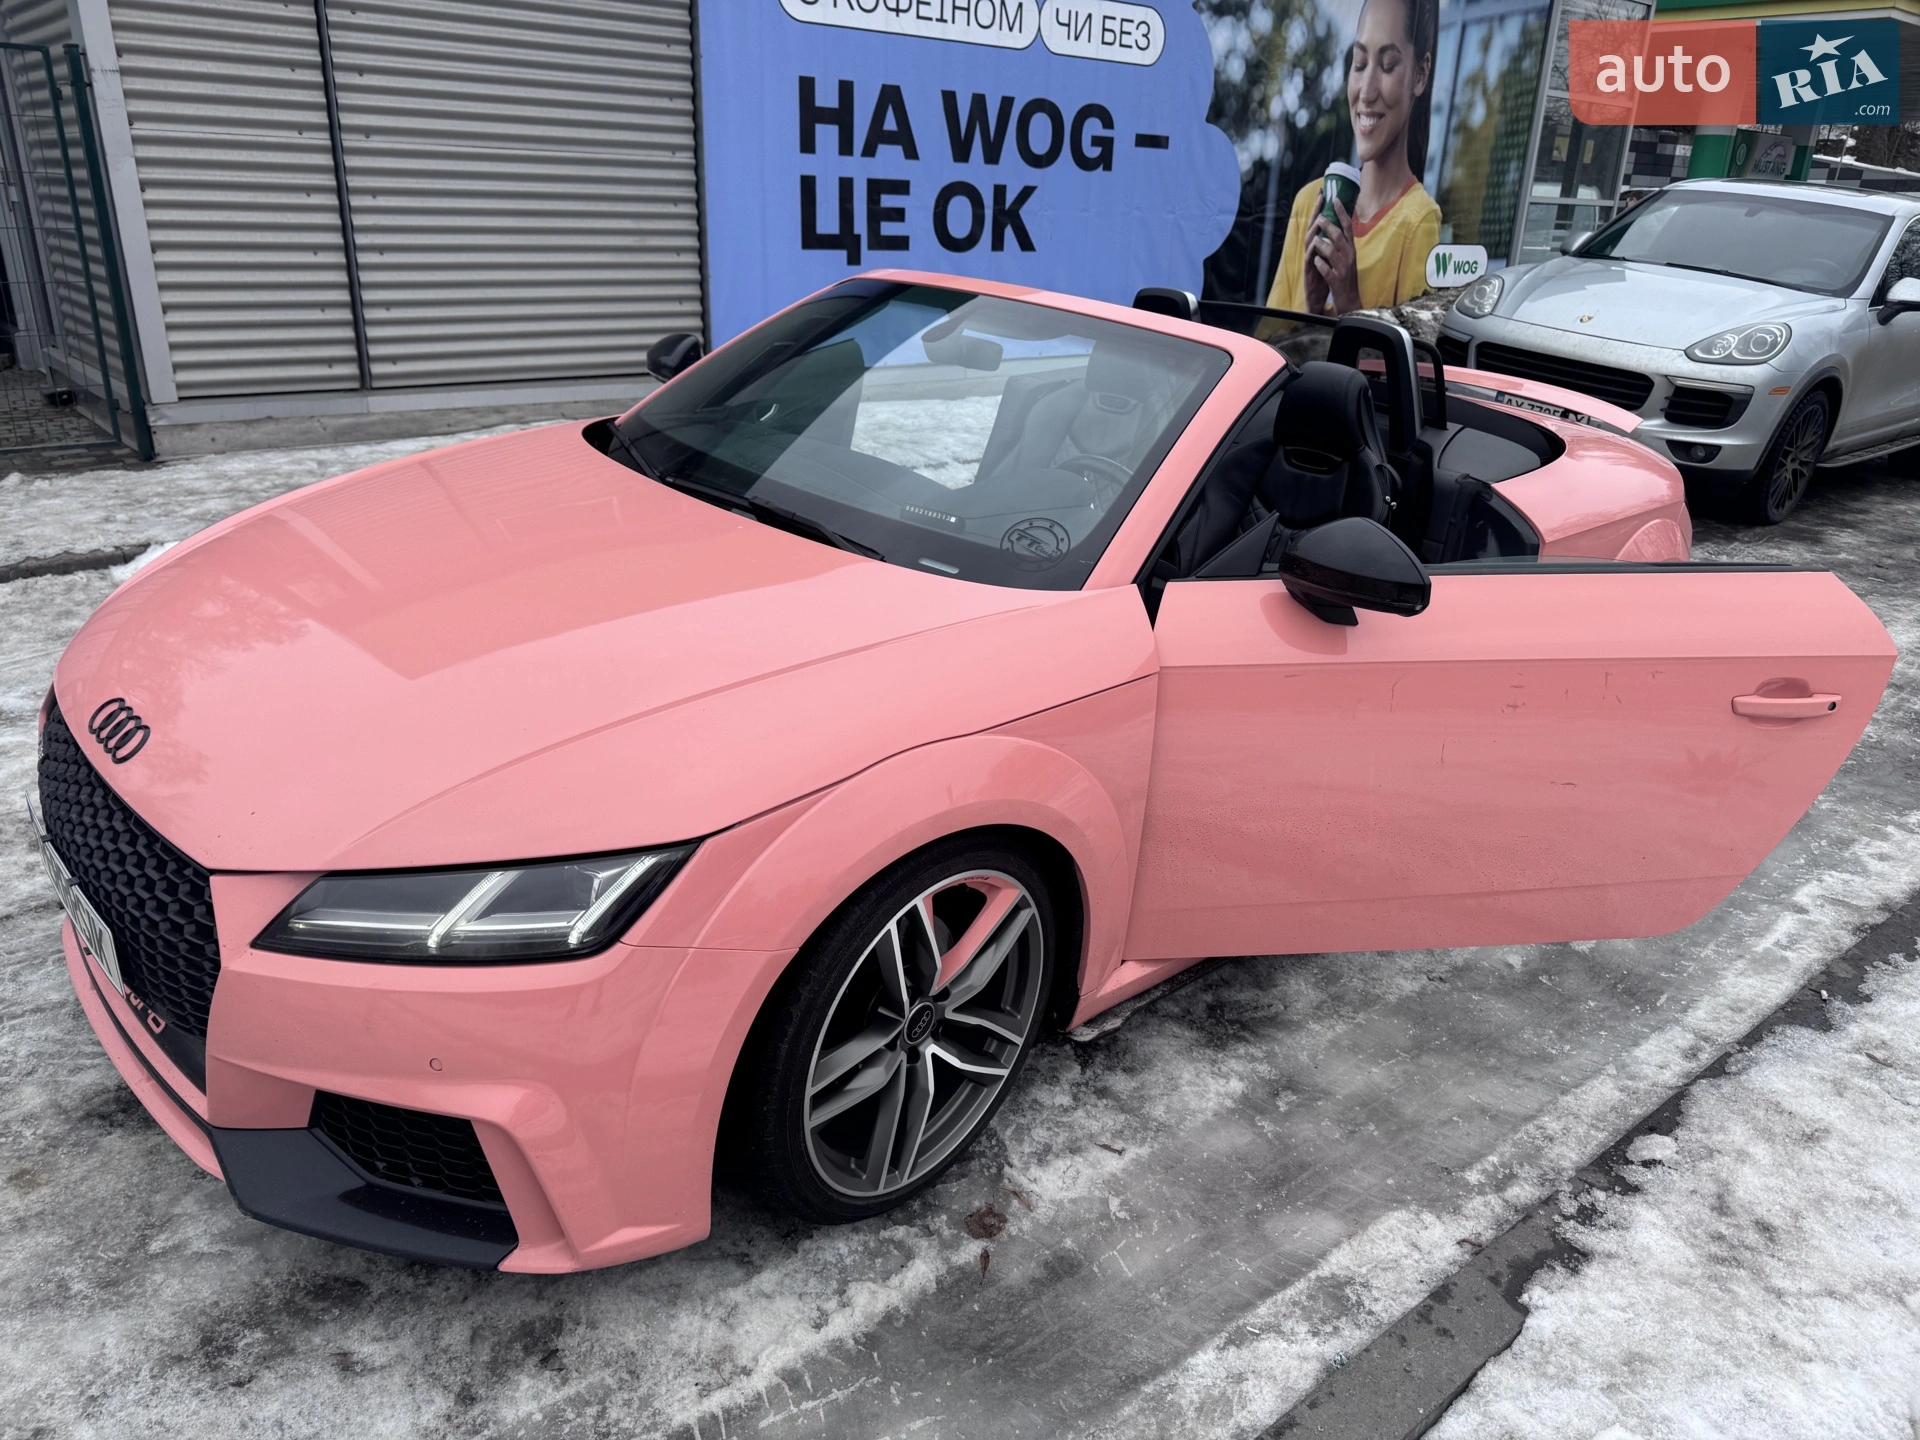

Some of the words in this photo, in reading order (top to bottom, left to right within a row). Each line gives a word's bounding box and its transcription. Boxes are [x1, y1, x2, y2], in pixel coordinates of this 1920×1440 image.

[1055, 7, 1092, 43] ЧИ
[1101, 15, 1150, 51] БЕЗ
[798, 75, 919, 161] НА
[941, 89, 1115, 172] WOG
[1752, 158, 1787, 176] MUSTANG
[799, 174, 911, 266] ЦЕ
[932, 180, 1038, 253] ОК
[1453, 260, 1478, 275] WOG
[1015, 533, 1042, 548] TT
